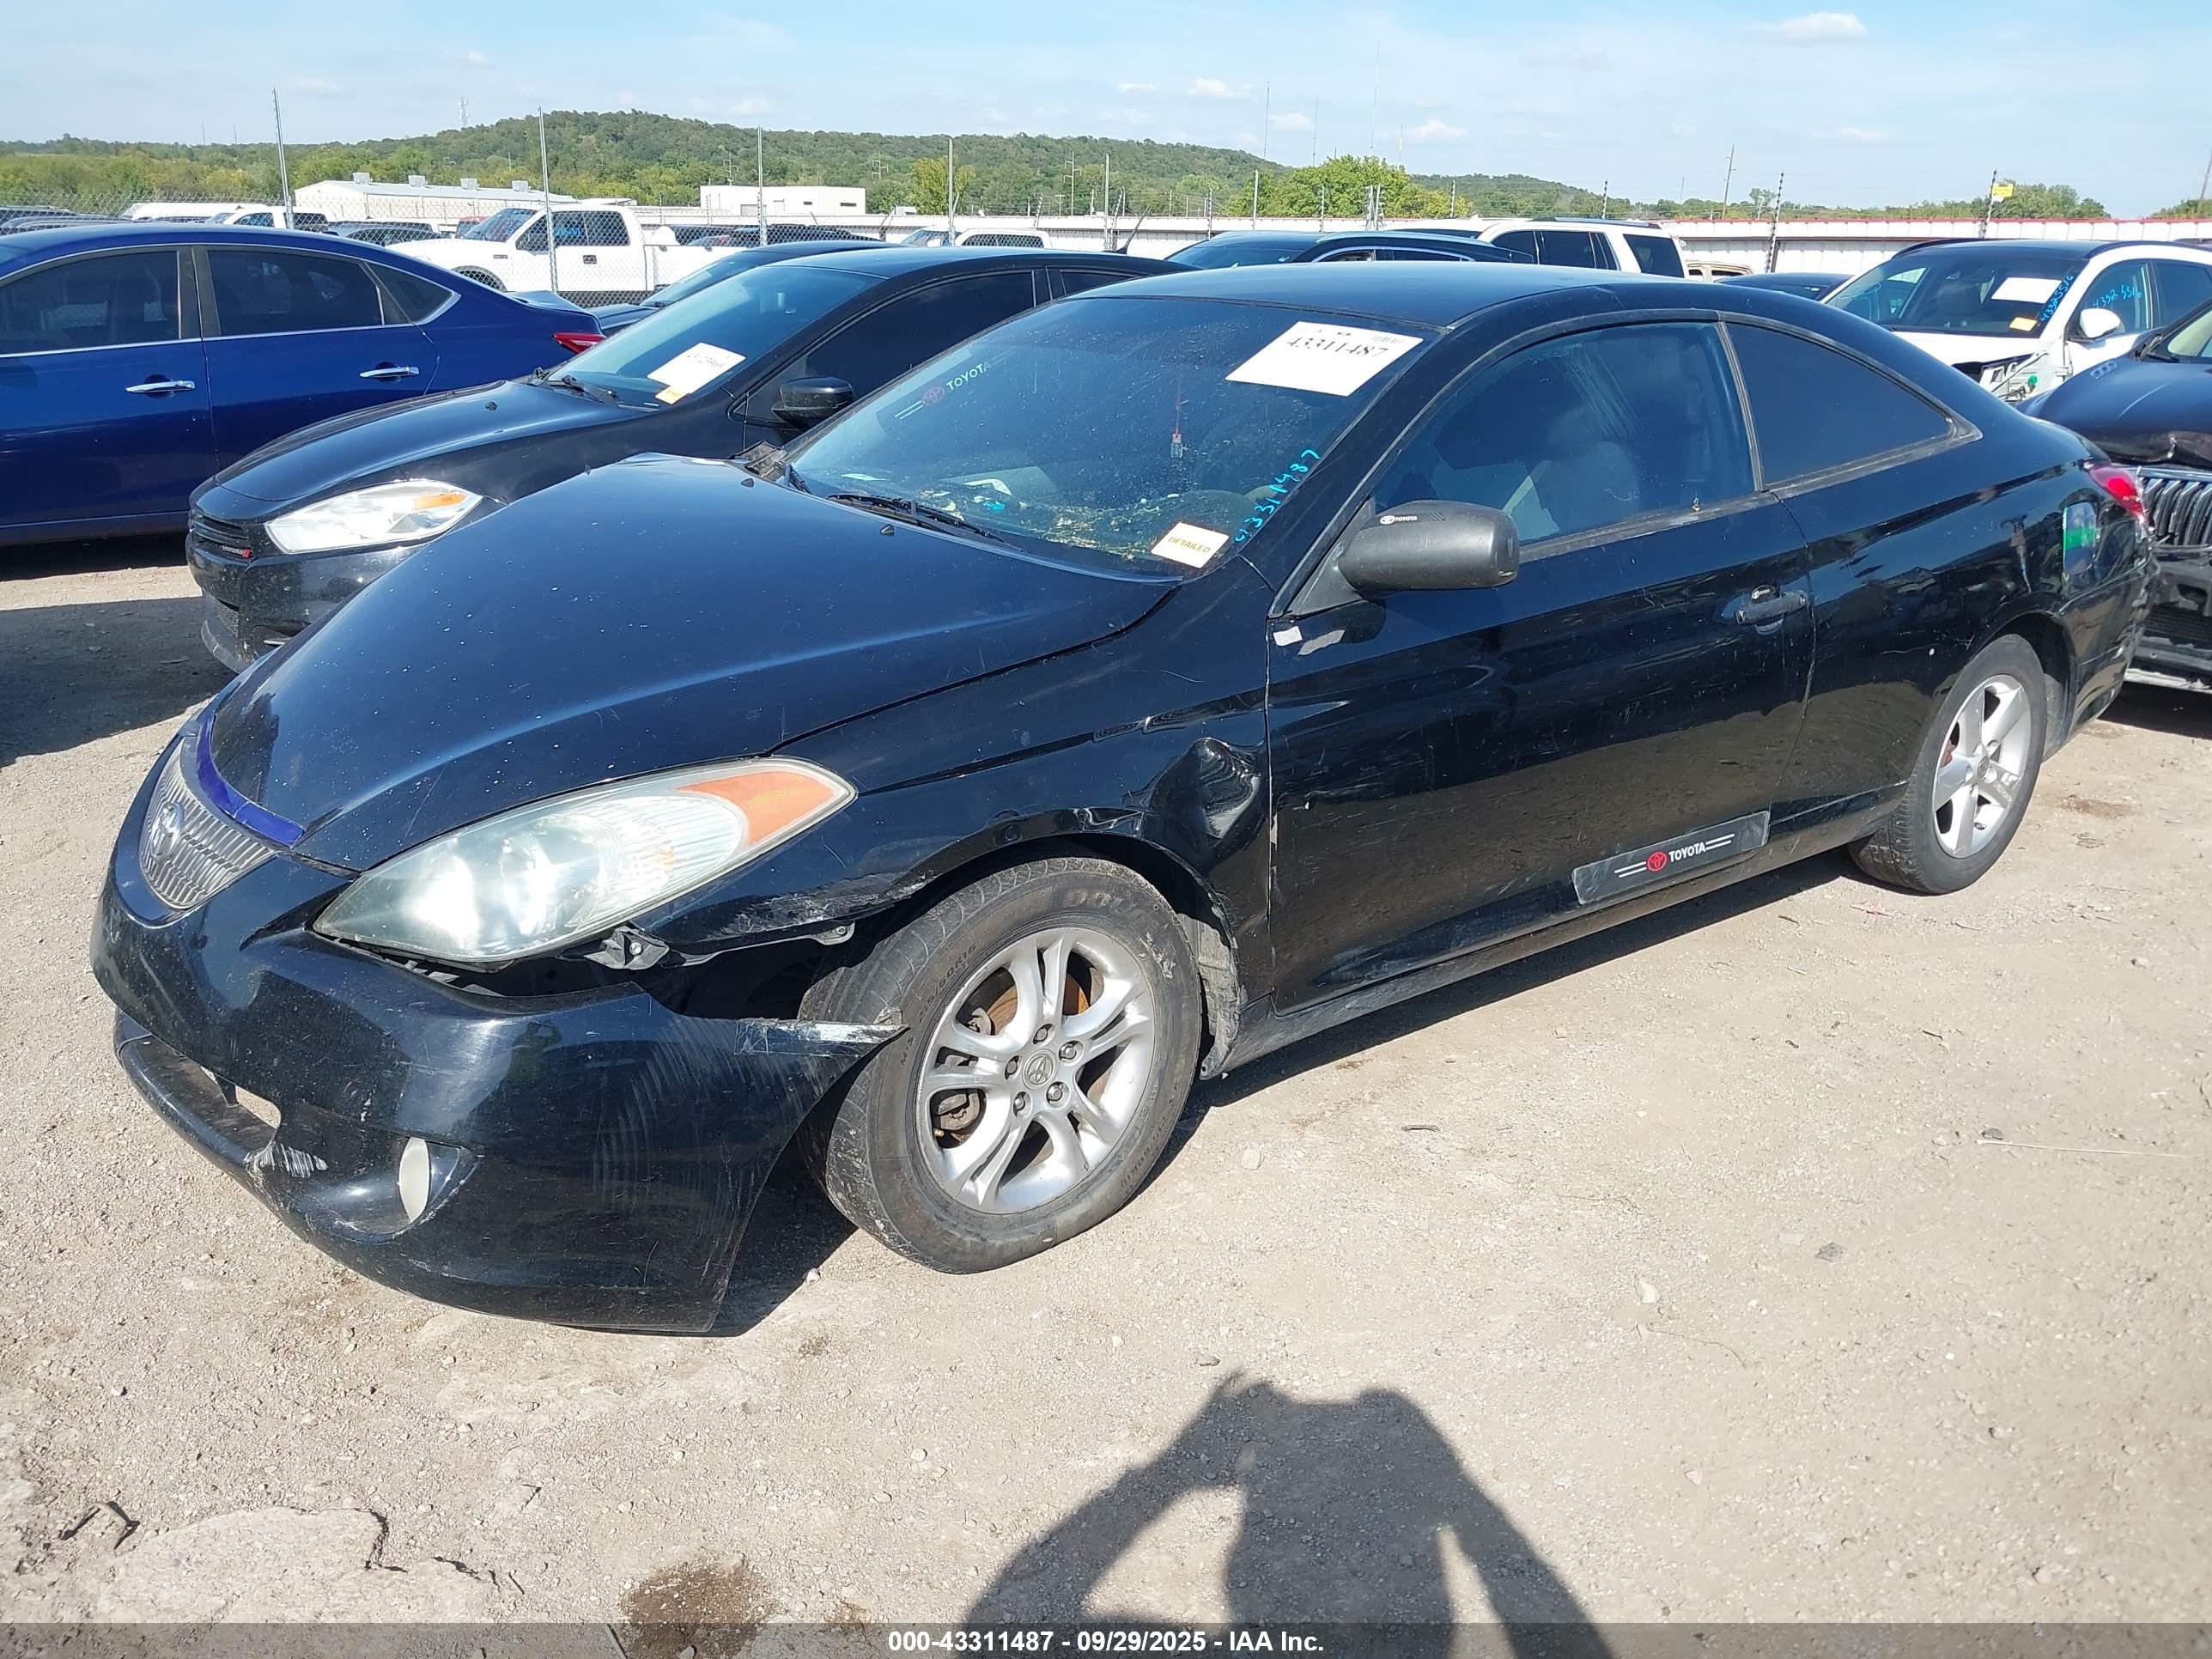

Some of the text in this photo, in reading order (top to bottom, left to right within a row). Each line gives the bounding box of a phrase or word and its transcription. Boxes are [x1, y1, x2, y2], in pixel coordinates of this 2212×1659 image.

[1286, 336, 1389, 358] 43311487
[946, 361, 992, 391] TOYOTA
[1168, 537, 1211, 554] DETAILED
[1668, 842, 1706, 863] TOYOTA
